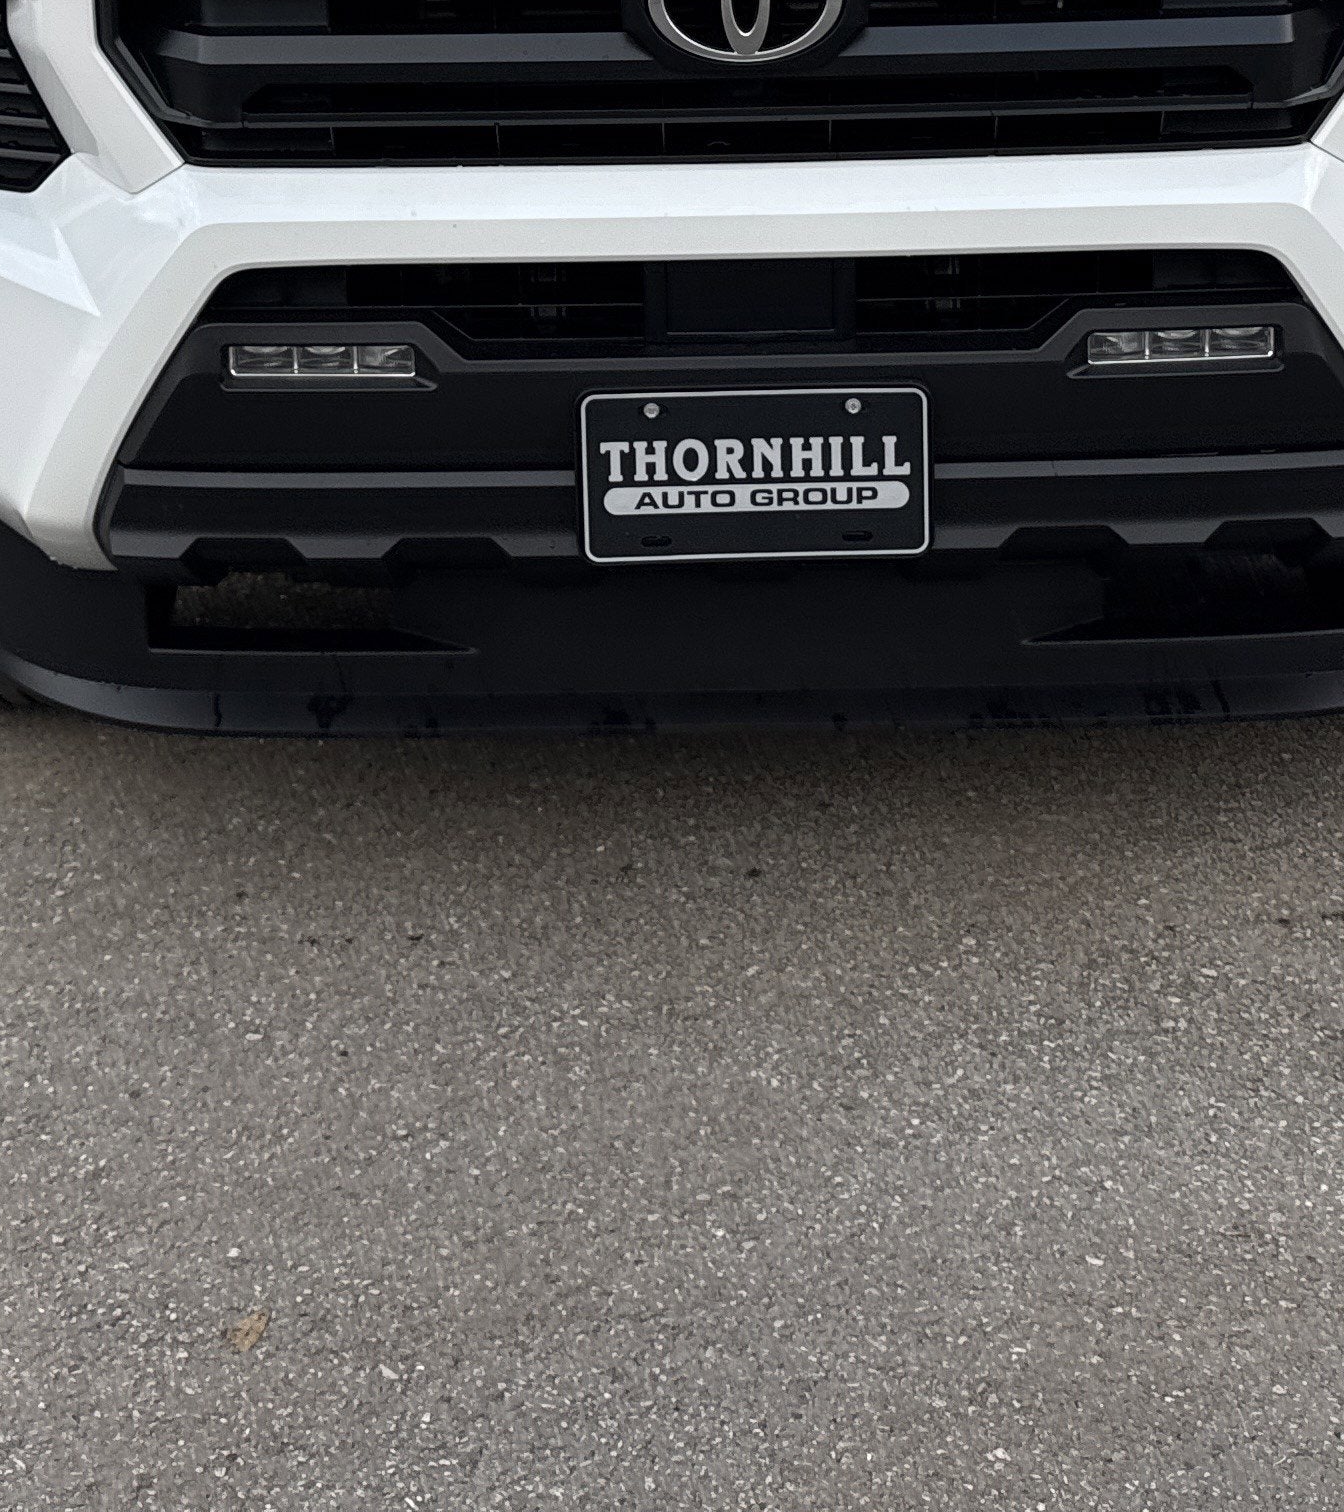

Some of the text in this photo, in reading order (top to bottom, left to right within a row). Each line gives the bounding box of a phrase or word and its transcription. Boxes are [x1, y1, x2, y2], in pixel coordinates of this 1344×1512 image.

[599, 436, 911, 482] THORNHILL
[634, 486, 878, 510] AUTO GROUP
